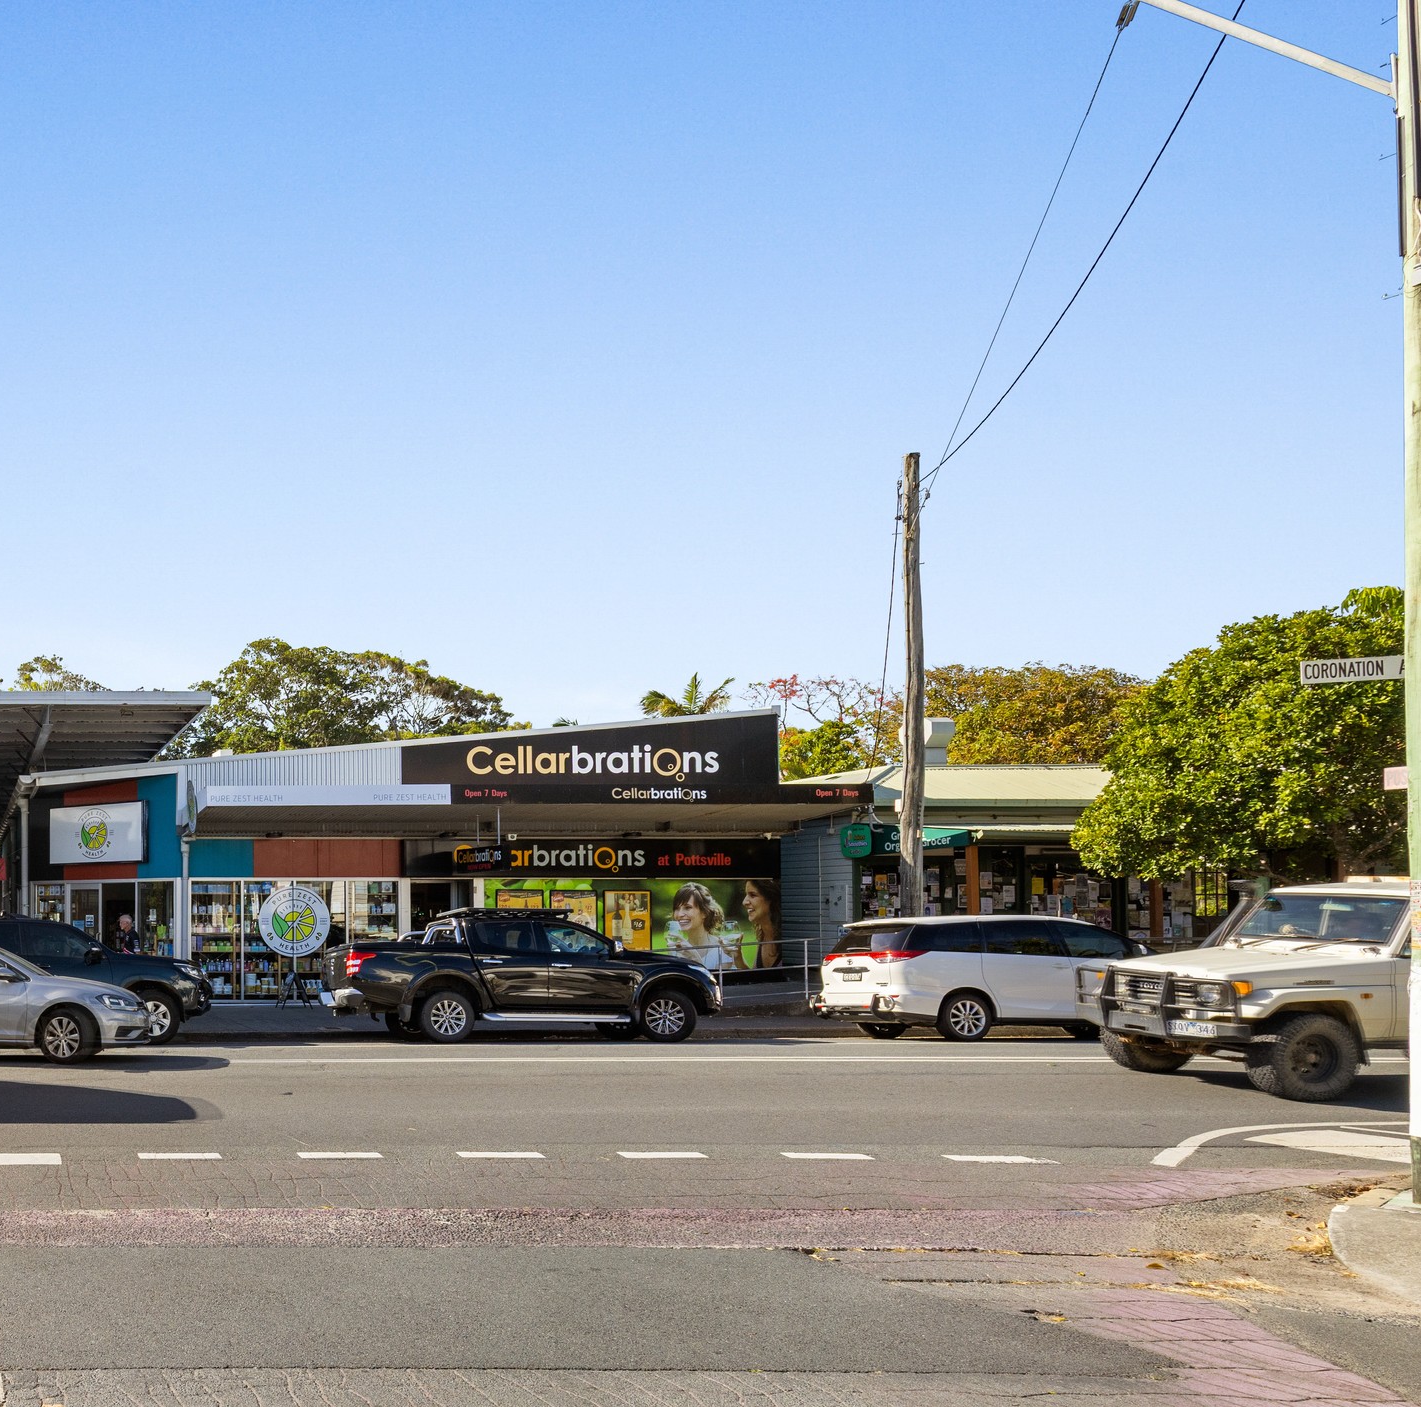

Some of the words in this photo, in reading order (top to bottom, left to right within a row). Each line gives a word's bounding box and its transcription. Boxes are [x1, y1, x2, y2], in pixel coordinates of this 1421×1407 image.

[1304, 660, 1384, 680] CORONATION
[1399, 659, 1405, 675] A
[466, 744, 720, 782] Cellarbrations
[417, 793, 447, 801] HEALTH
[464, 789, 482, 798] Open
[484, 789, 489, 797] 7
[491, 789, 507, 798] Days
[611, 788, 707, 803] Cellarbrations
[816, 789, 832, 798] Open
[843, 789, 859, 797] Days
[81, 811, 94, 822] PURE
[96, 811, 108, 820] ZEST
[454, 845, 646, 873] arbrations
[658, 853, 670, 866] at
[675, 853, 732, 866] Pottsville
[458, 849, 502, 864] Cellarbrations
[272, 892, 292, 905] PURE
[297, 892, 316, 904] ZEST
[279, 943, 310, 951] HEALTH
